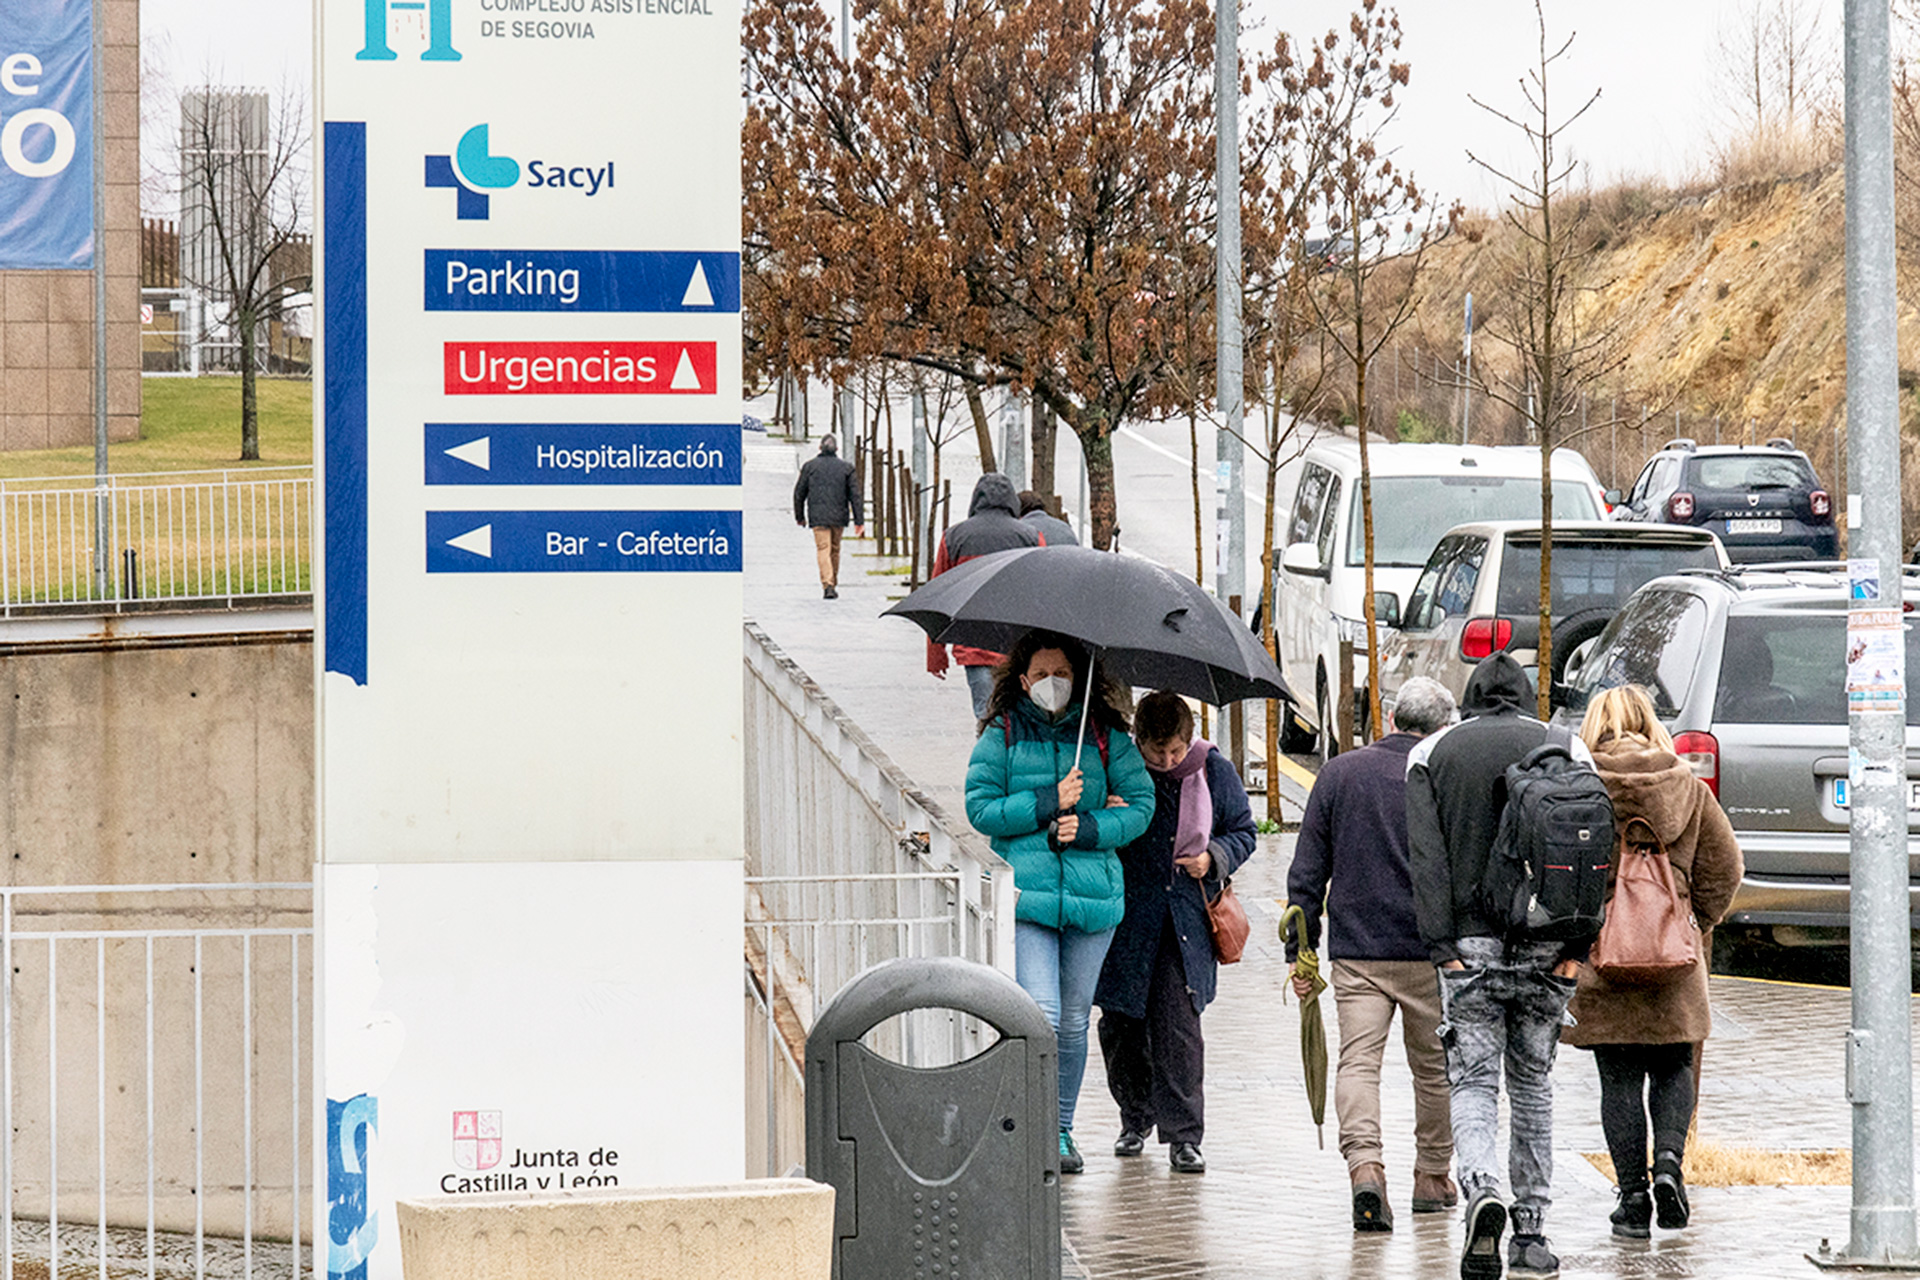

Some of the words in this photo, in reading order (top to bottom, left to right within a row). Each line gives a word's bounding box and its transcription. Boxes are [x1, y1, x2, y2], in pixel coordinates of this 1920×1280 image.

[480, 0, 585, 13] COMPLEJO
[590, 0, 714, 15] ASISTENCIAL
[481, 20, 506, 38] DE
[511, 21, 595, 39] SEGOVIA
[527, 160, 615, 197] Sacyl
[447, 260, 580, 304] Parking
[458, 349, 657, 391] Urgencias
[536, 442, 723, 474] Hospitalización
[546, 532, 589, 556] Bar
[616, 529, 729, 556] Cafetería
[509, 1148, 579, 1168] Junta
[588, 1147, 619, 1167] de
[440, 1173, 528, 1194] Castilla
